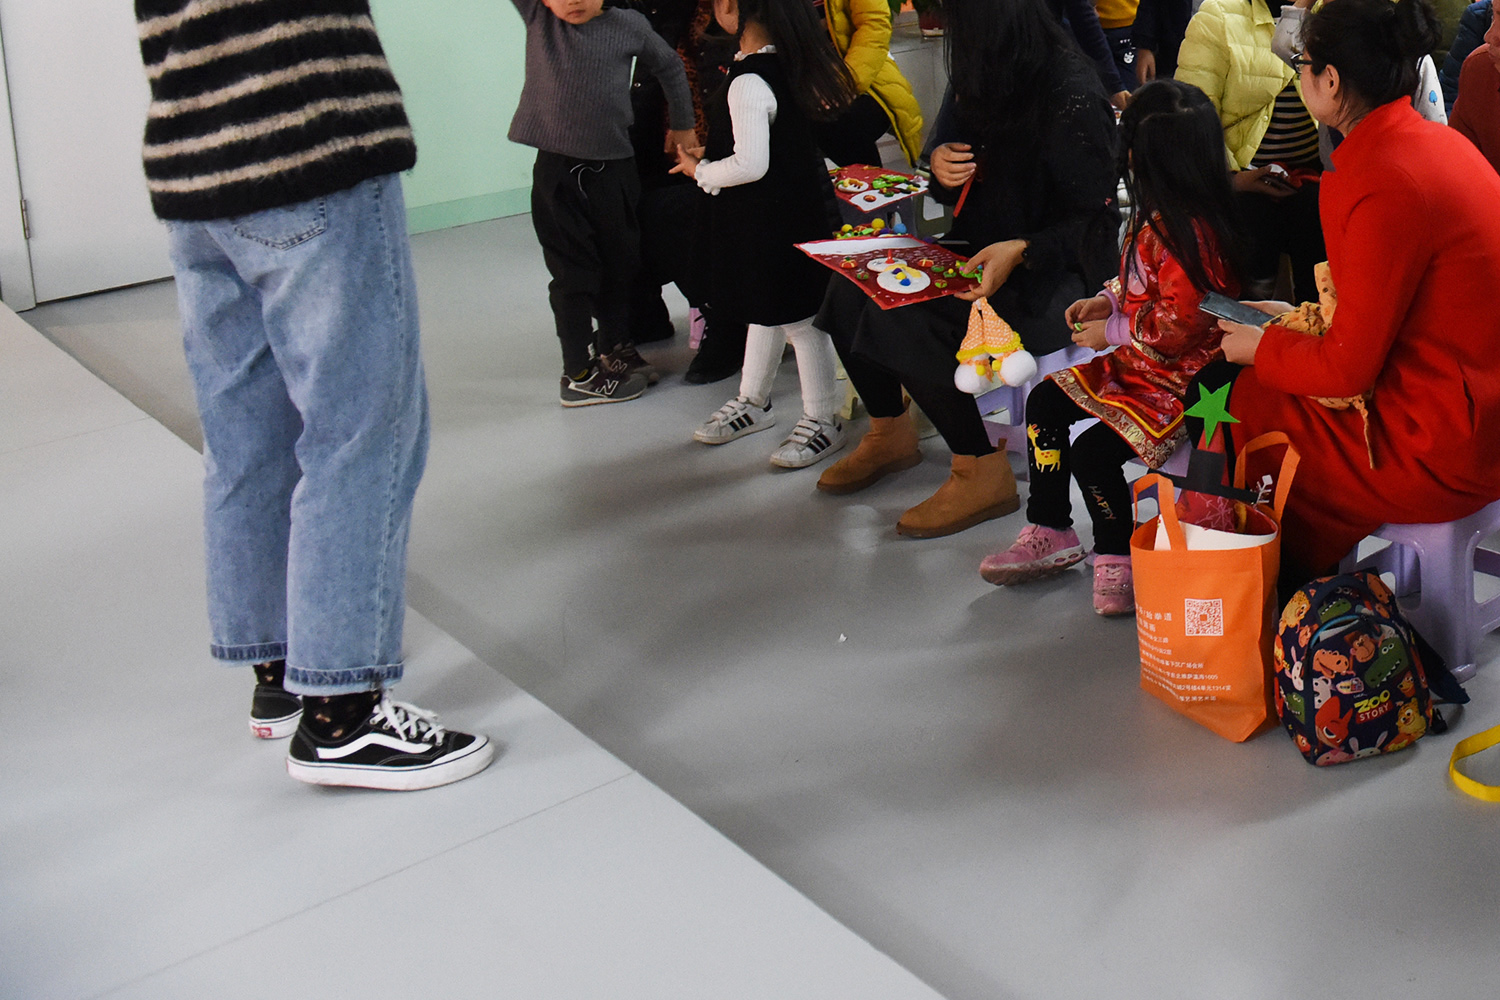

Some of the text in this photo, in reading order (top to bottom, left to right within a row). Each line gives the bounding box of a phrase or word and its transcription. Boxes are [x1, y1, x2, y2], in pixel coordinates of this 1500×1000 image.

[1088, 485, 1117, 520] HAPPY
[1354, 689, 1391, 713] ZOO
[1360, 702, 1389, 721] STORY
